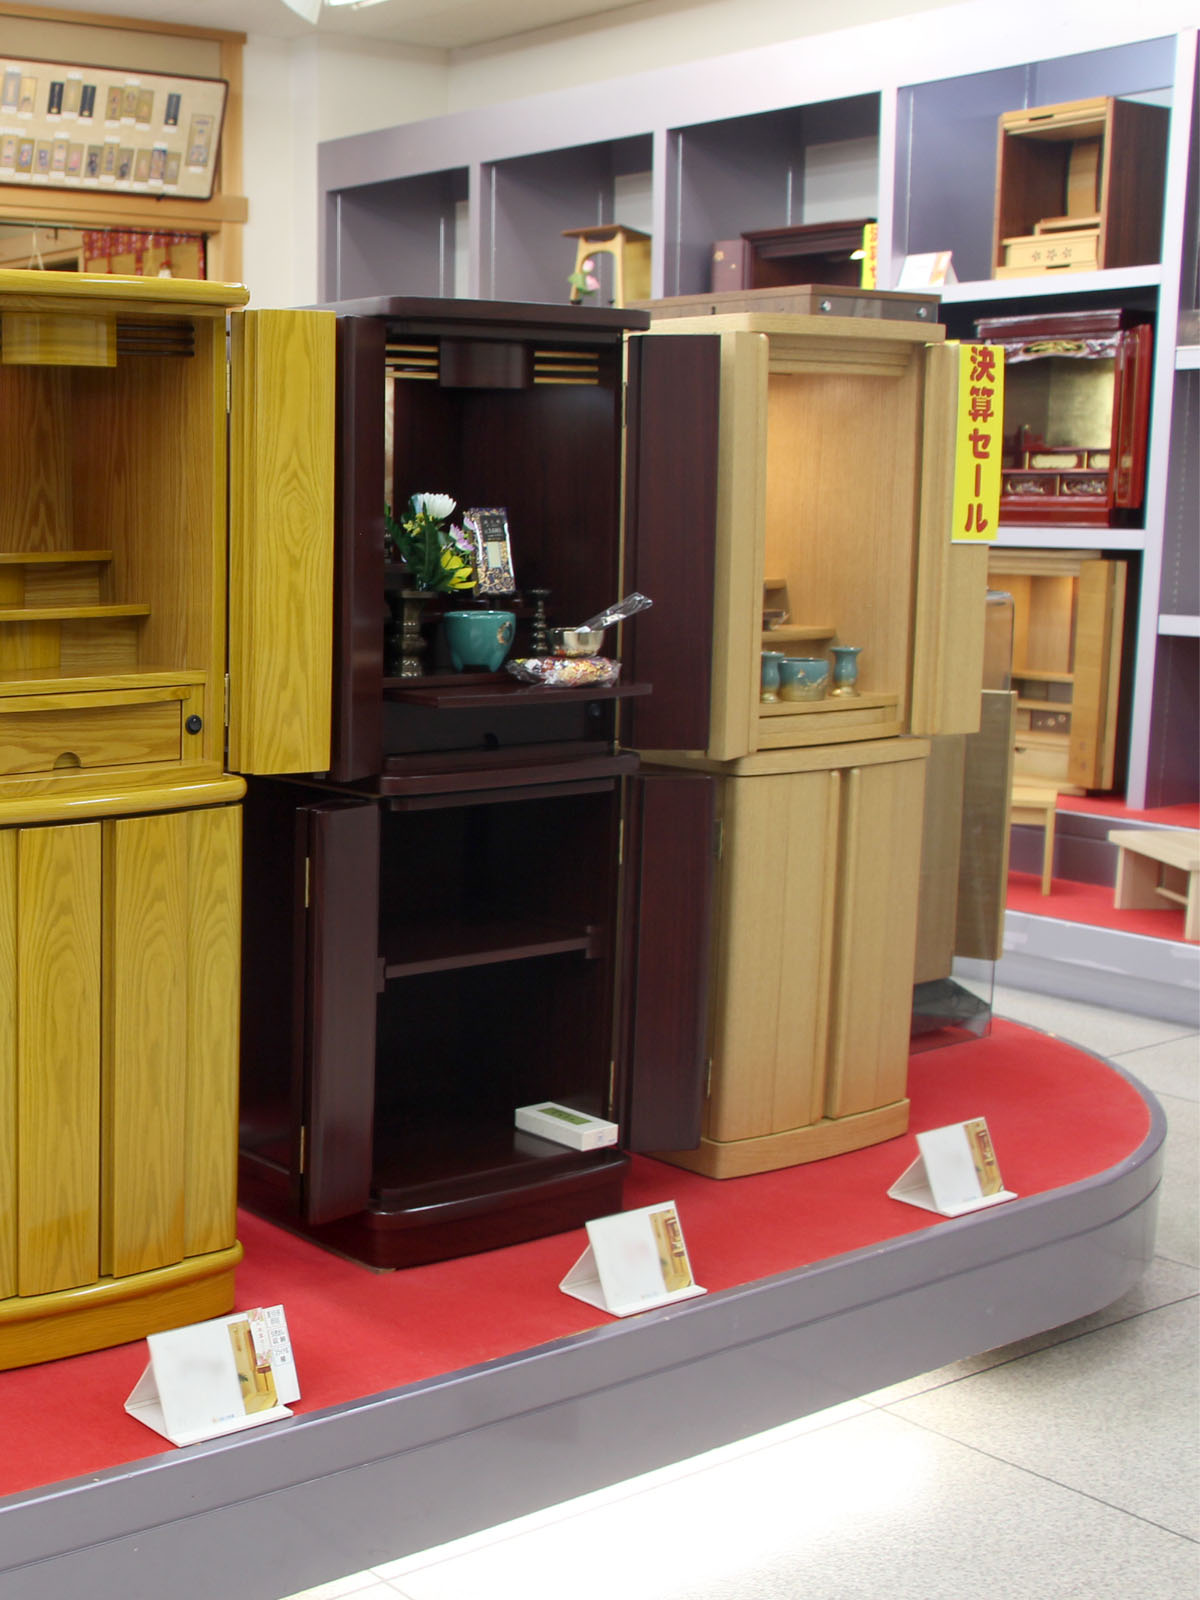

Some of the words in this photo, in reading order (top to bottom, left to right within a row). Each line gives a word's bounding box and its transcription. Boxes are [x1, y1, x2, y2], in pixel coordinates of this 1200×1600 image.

[964, 346, 996, 533] 決算セール
